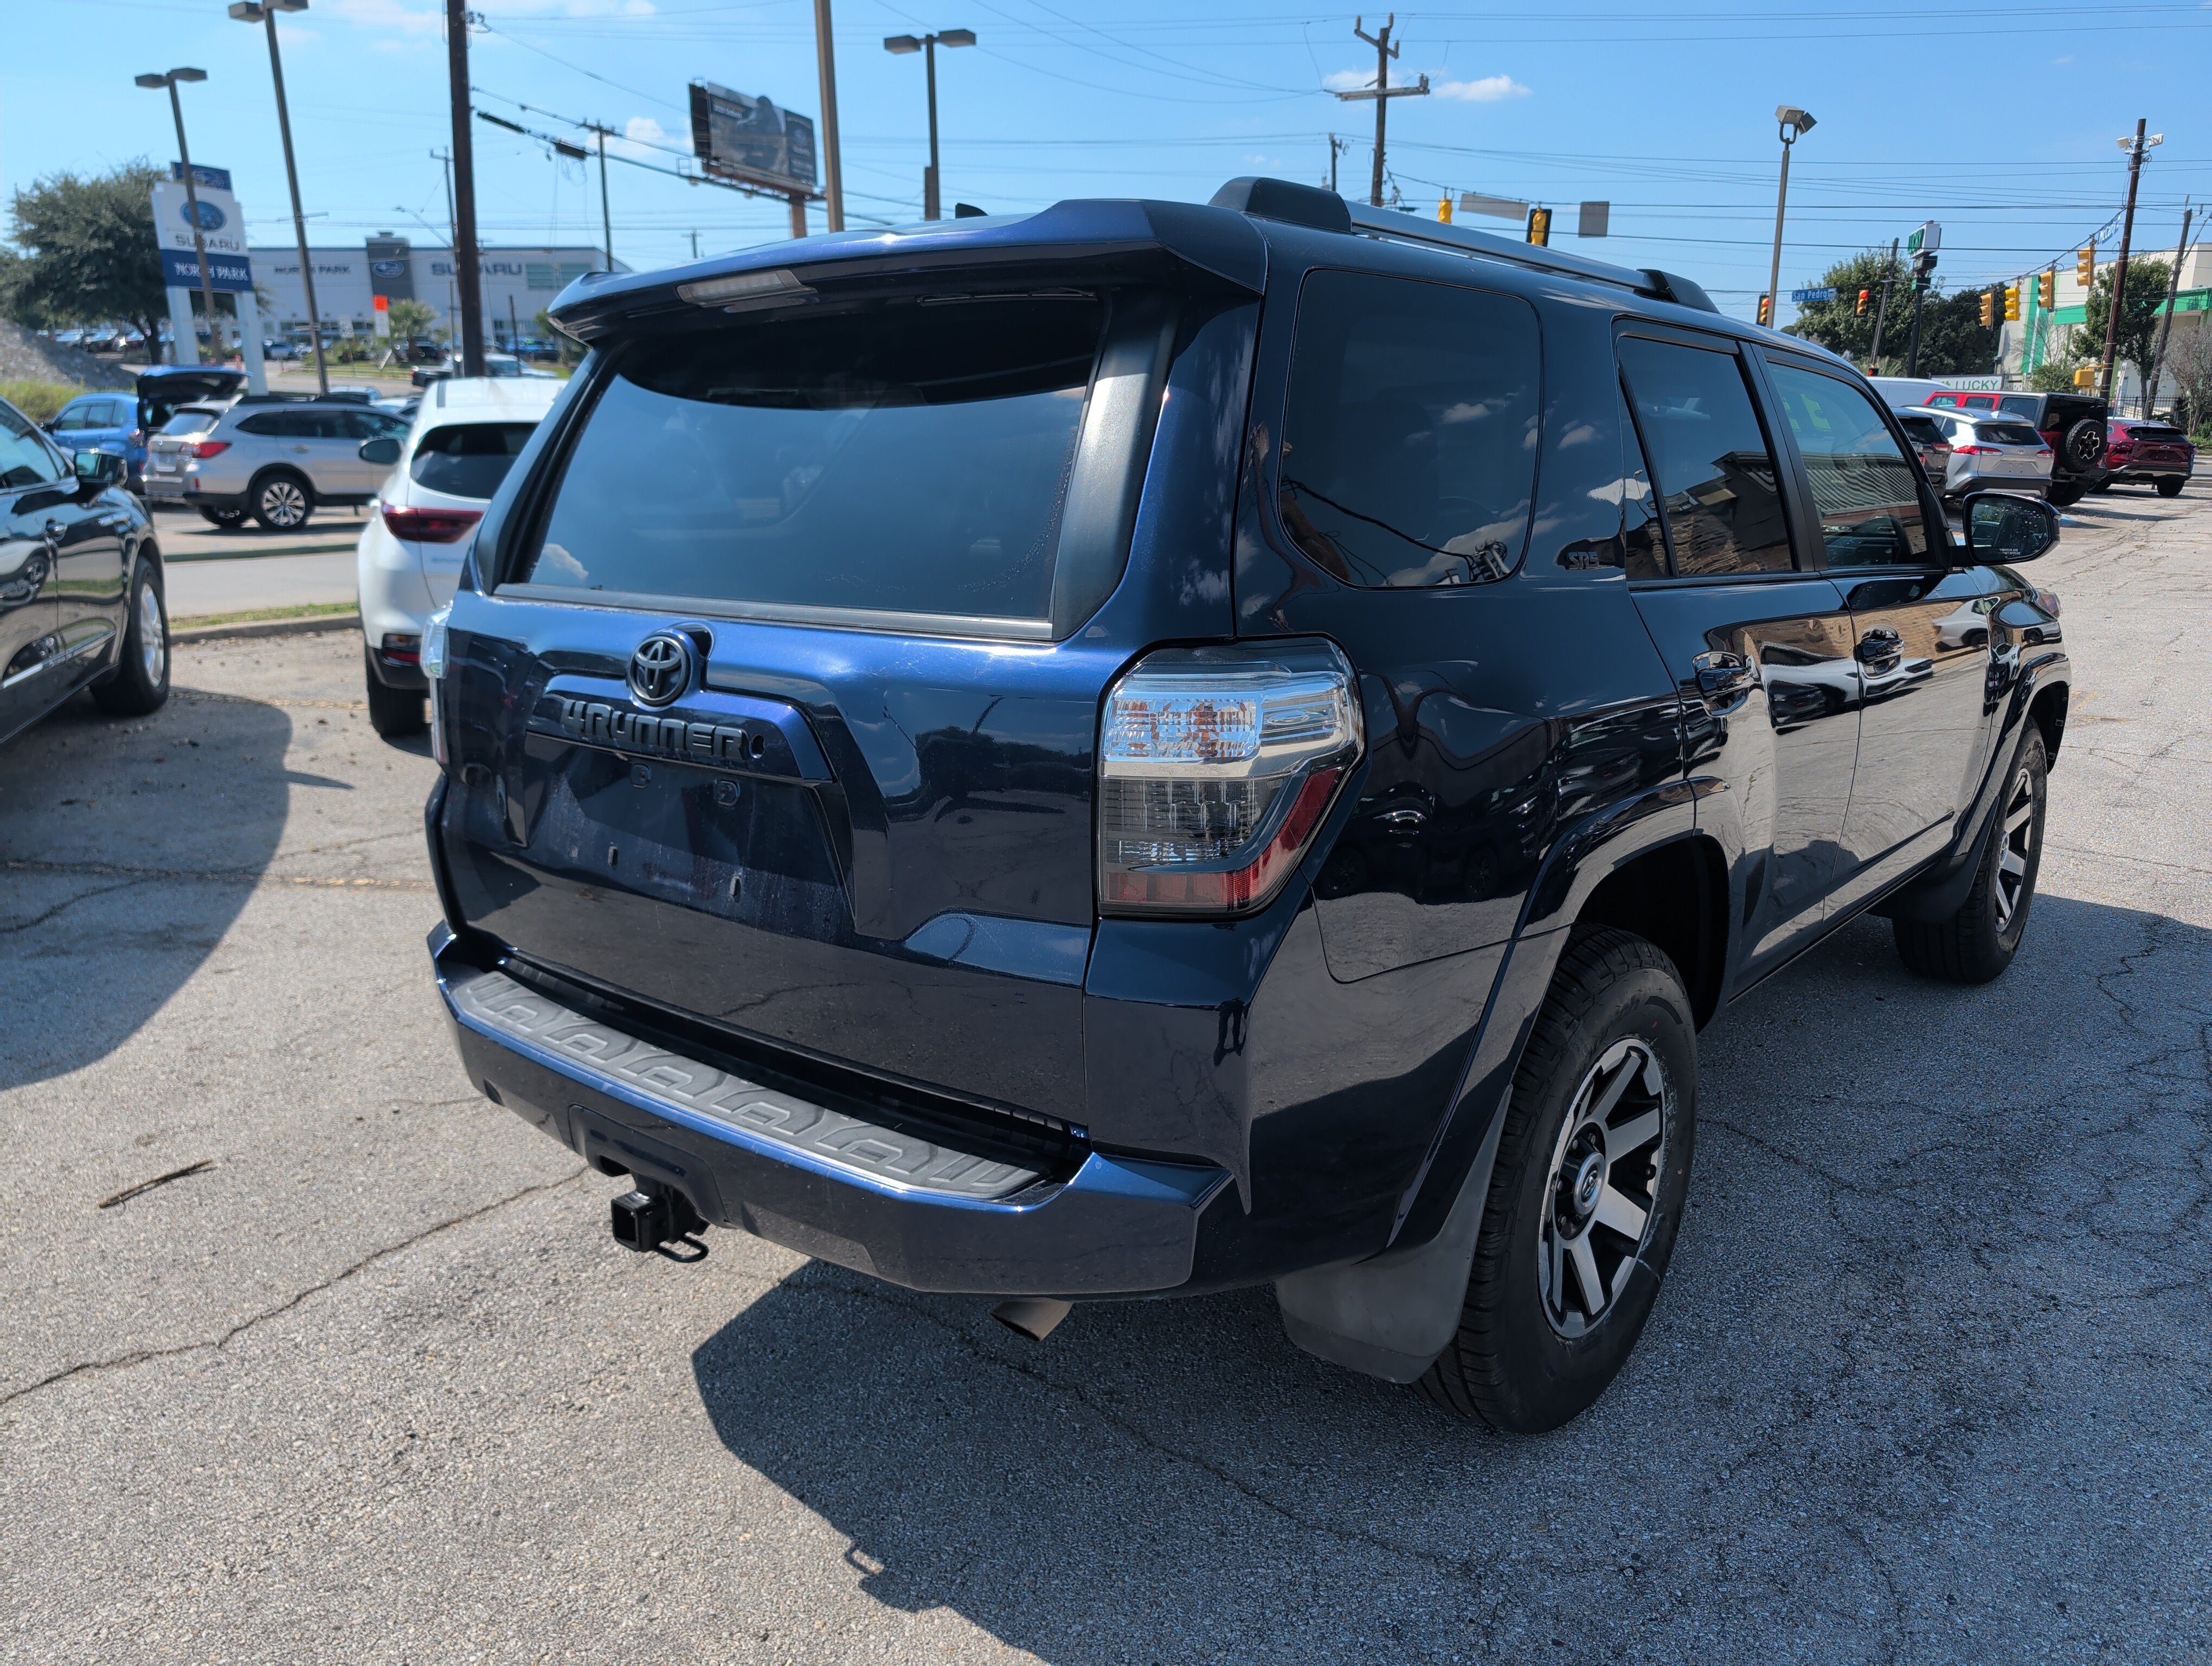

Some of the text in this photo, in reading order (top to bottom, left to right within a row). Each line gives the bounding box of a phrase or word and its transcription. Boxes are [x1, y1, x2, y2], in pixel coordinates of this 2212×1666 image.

[174, 262, 249, 281] NORH PARK
[274, 264, 316, 274] NOR
[431, 262, 523, 276] SUARU
[1793, 292, 1805, 300] San
[1807, 289, 1827, 299] Pedro
[1955, 380, 1998, 390] LUCKY
[1567, 551, 1600, 571] SR5
[561, 699, 745, 760] 4RUNNER
